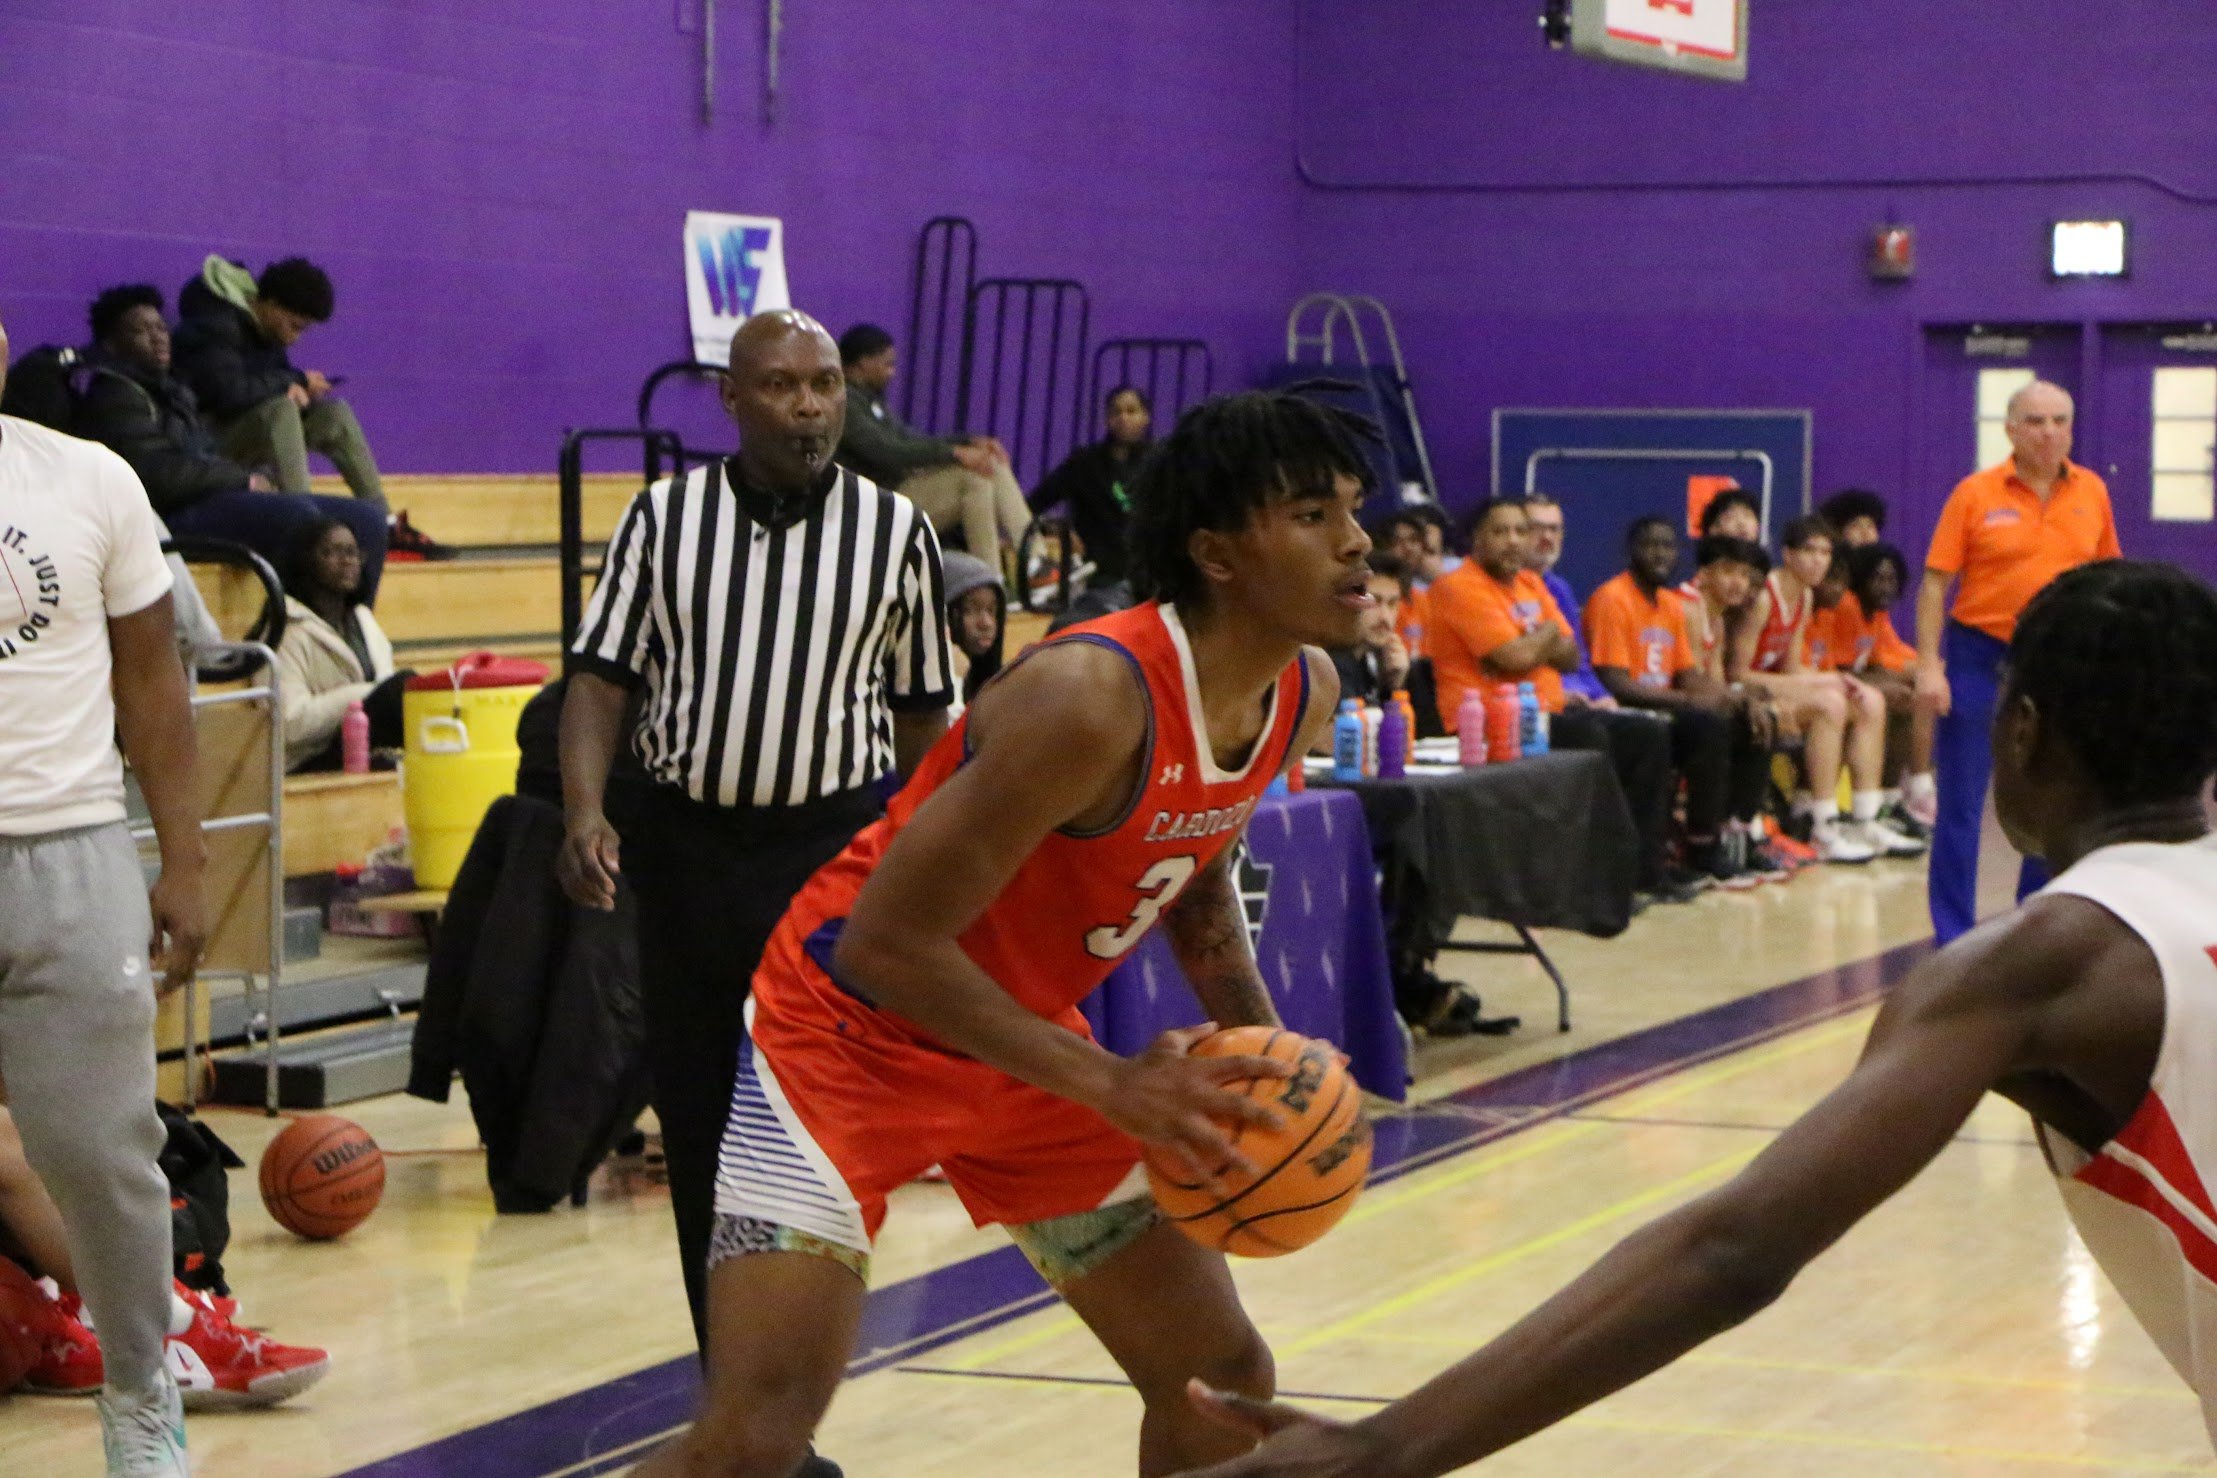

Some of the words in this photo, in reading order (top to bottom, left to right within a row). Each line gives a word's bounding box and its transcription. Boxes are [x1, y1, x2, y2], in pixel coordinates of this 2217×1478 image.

[2, 525, 28, 554] IT.
[28, 554, 60, 608] JUST
[18, 612, 51, 642] DO
[1084, 854, 1197, 961] 3
